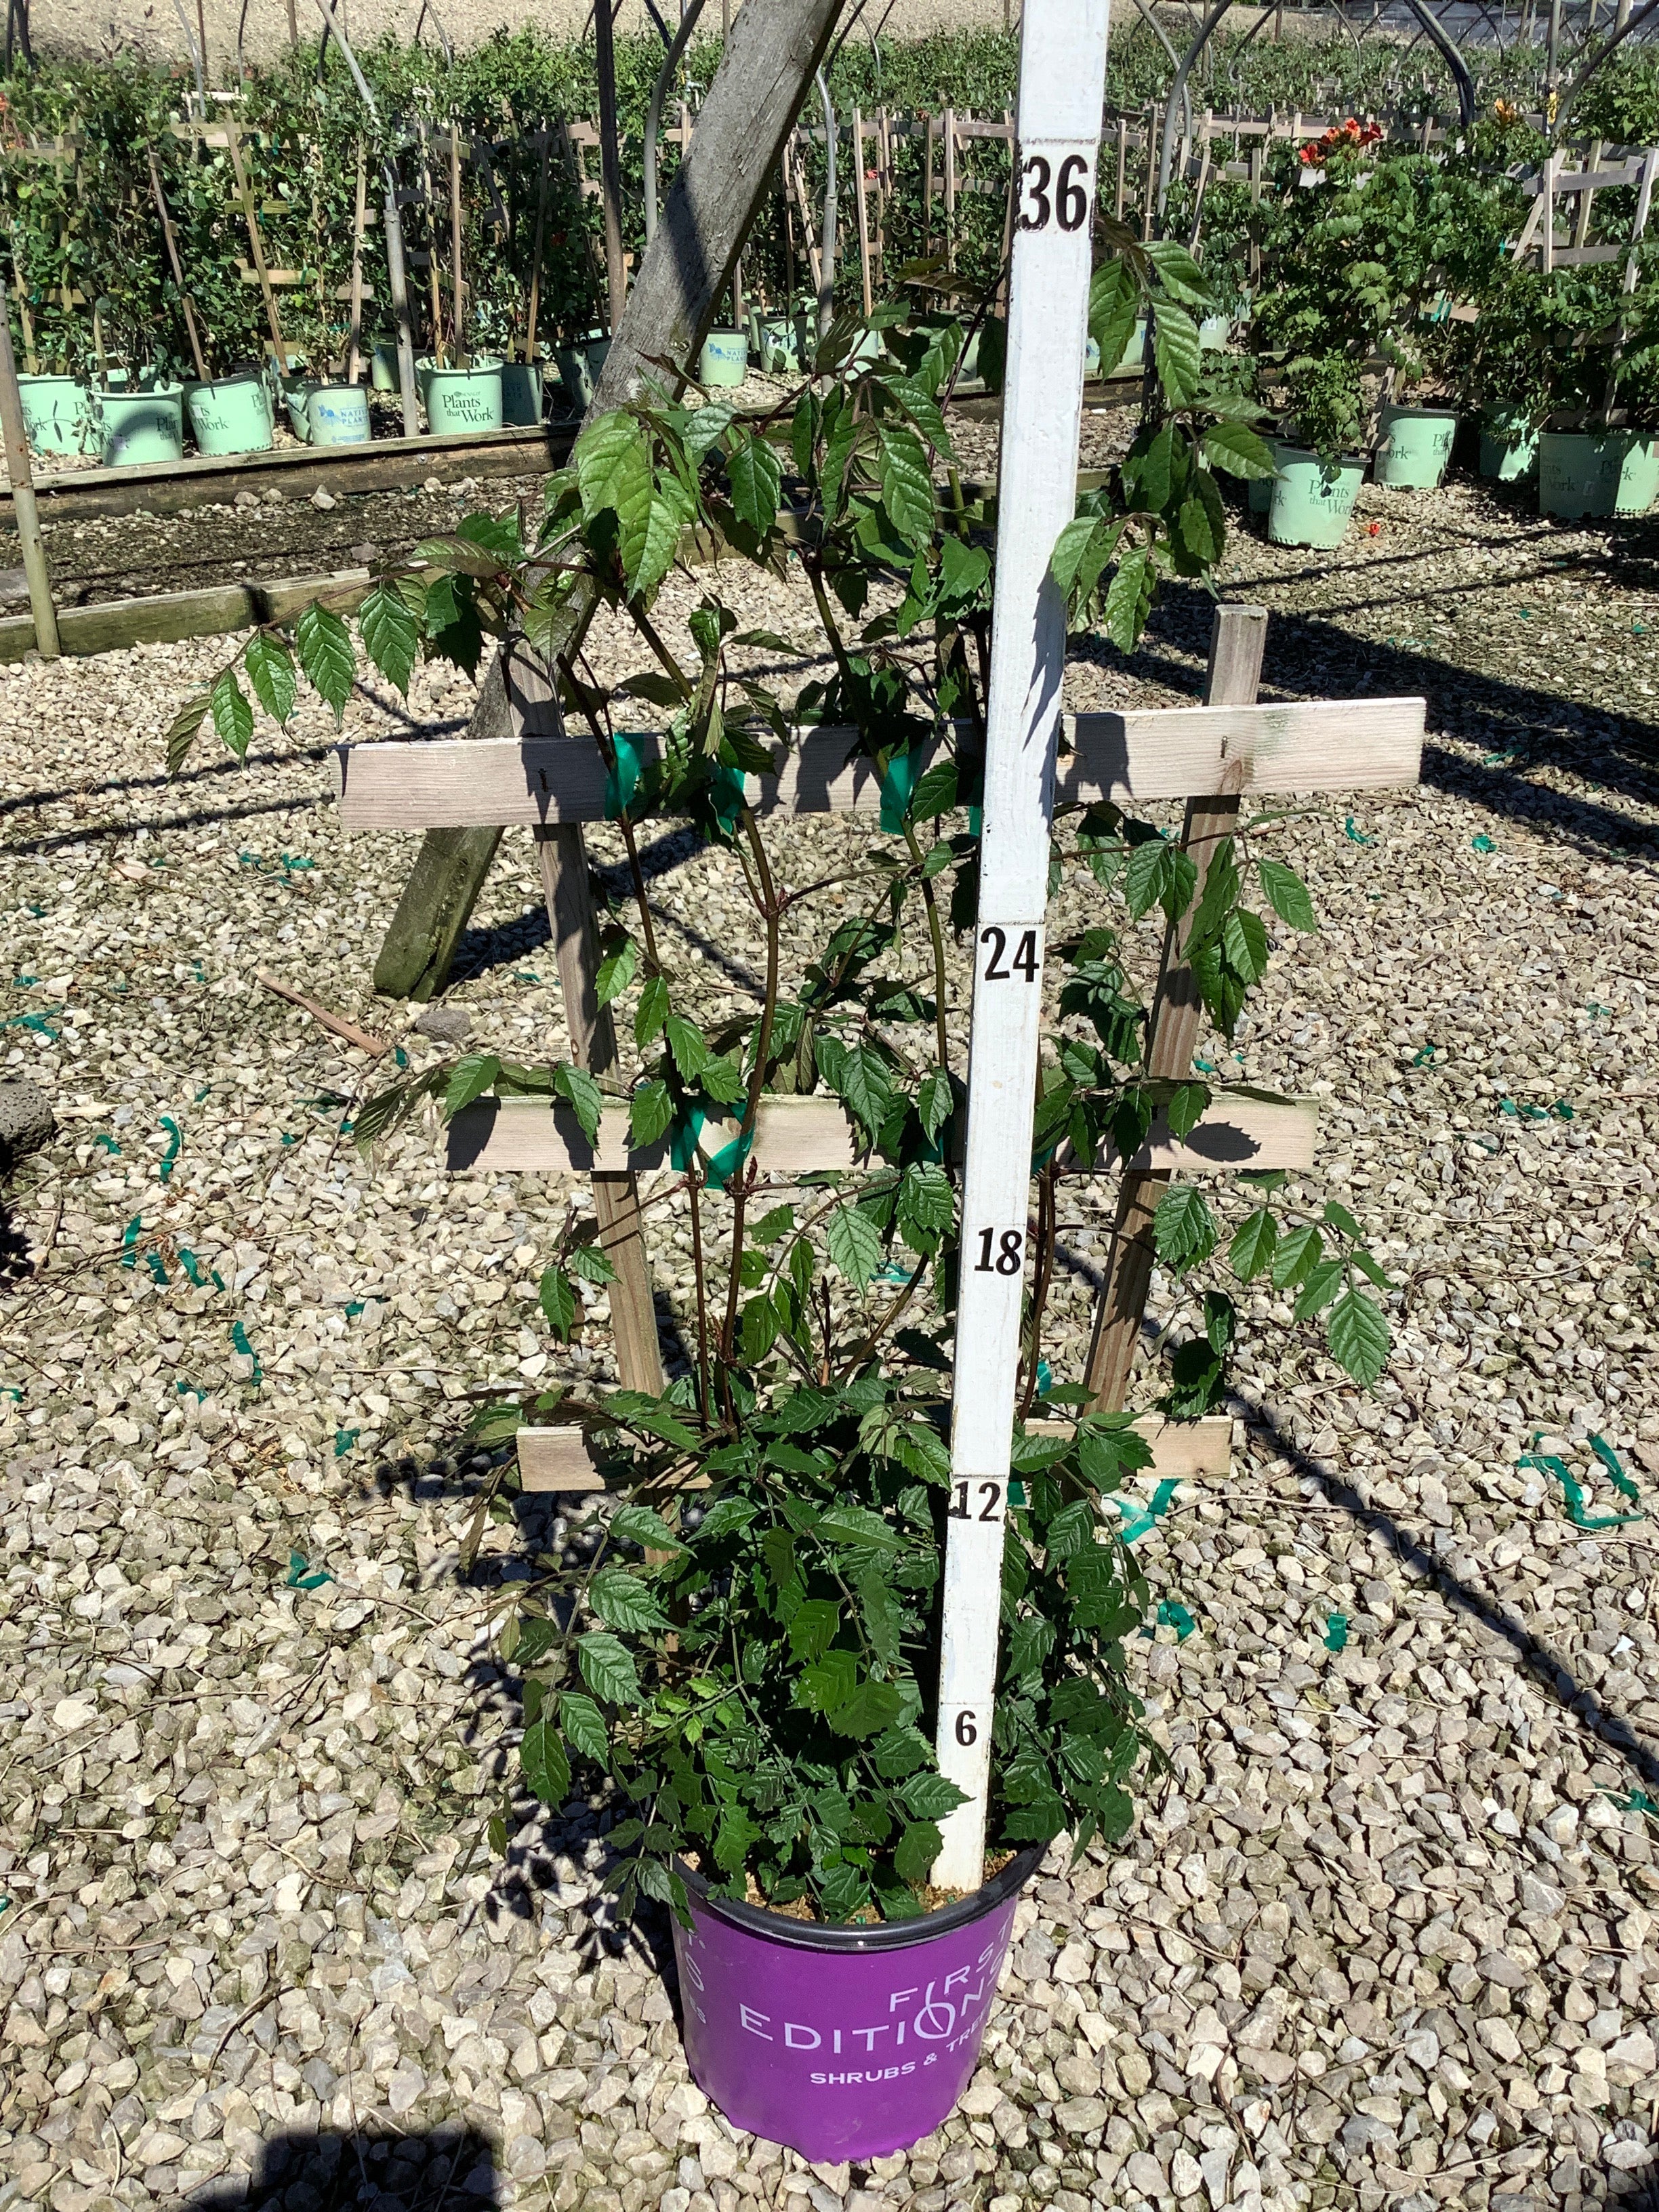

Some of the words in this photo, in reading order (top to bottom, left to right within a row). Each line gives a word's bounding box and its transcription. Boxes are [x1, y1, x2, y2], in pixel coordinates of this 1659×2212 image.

[1022, 155, 1088, 232] 36
[442, 394, 480, 408] Plants
[447, 409, 461, 417] that
[461, 407, 493, 422] Work
[1308, 478, 1350, 498] Plnts
[980, 926, 1040, 982] 24
[974, 1227, 1023, 1276] 18
[951, 1480, 1002, 1523] 12
[955, 1710, 977, 1746] 6
[810, 2062, 916, 2085] SHRUBS
[924, 2052, 938, 2066] &
